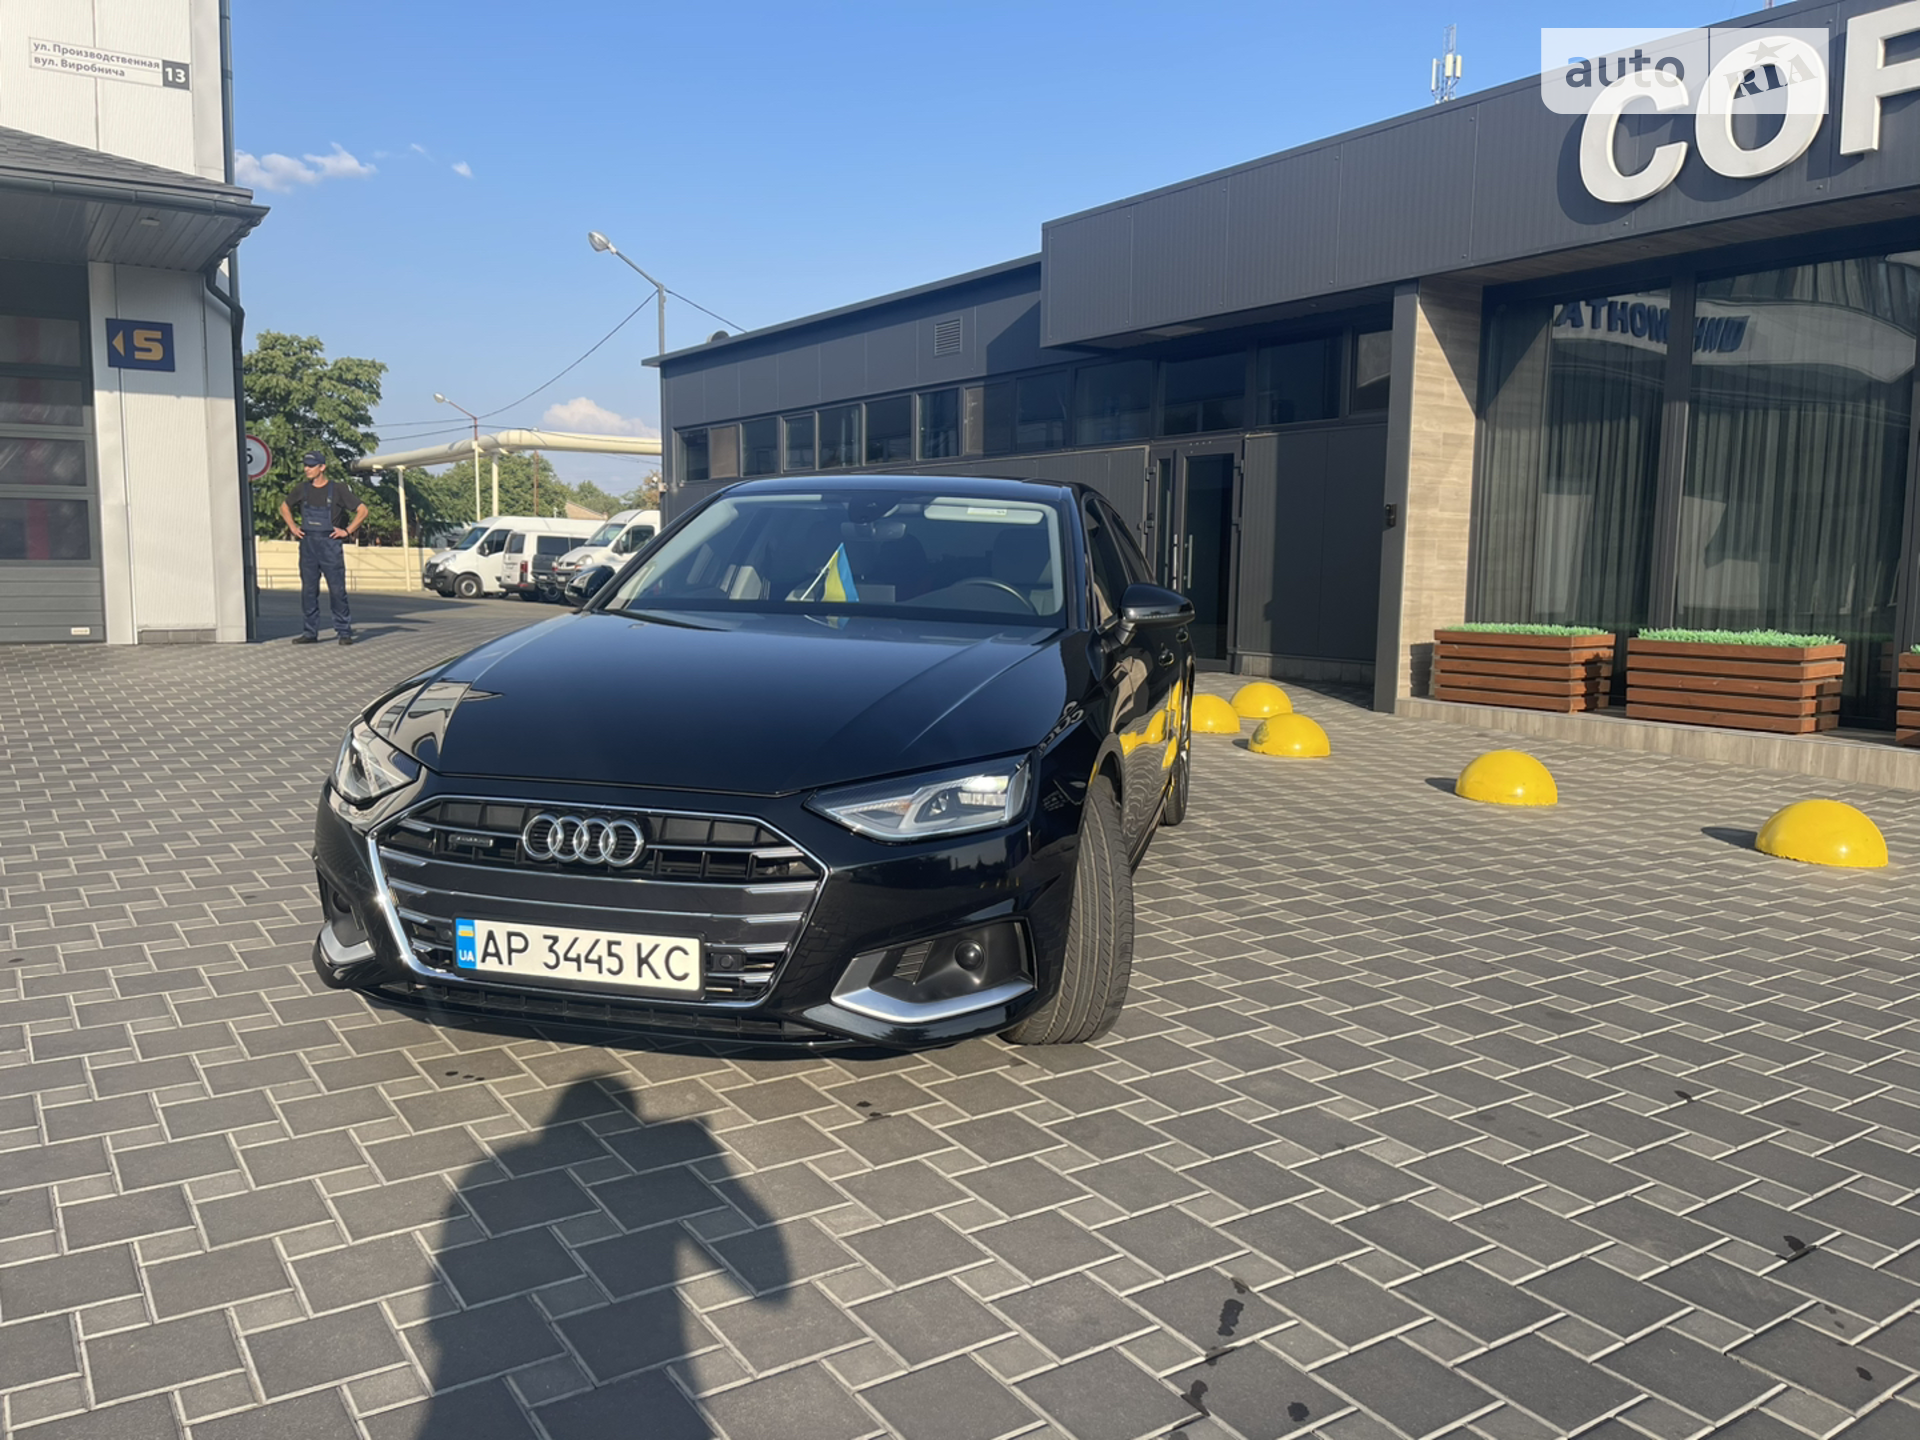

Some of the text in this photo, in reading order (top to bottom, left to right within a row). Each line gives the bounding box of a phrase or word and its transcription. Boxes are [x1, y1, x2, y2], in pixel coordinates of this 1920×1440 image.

[33, 42, 160, 69] ул. Производственная
[34, 56, 126, 77] вул. Виробнича
[164, 67, 186, 84] 13
[459, 949, 475, 962] UA
[480, 929, 691, 982] AP 3445 KC
